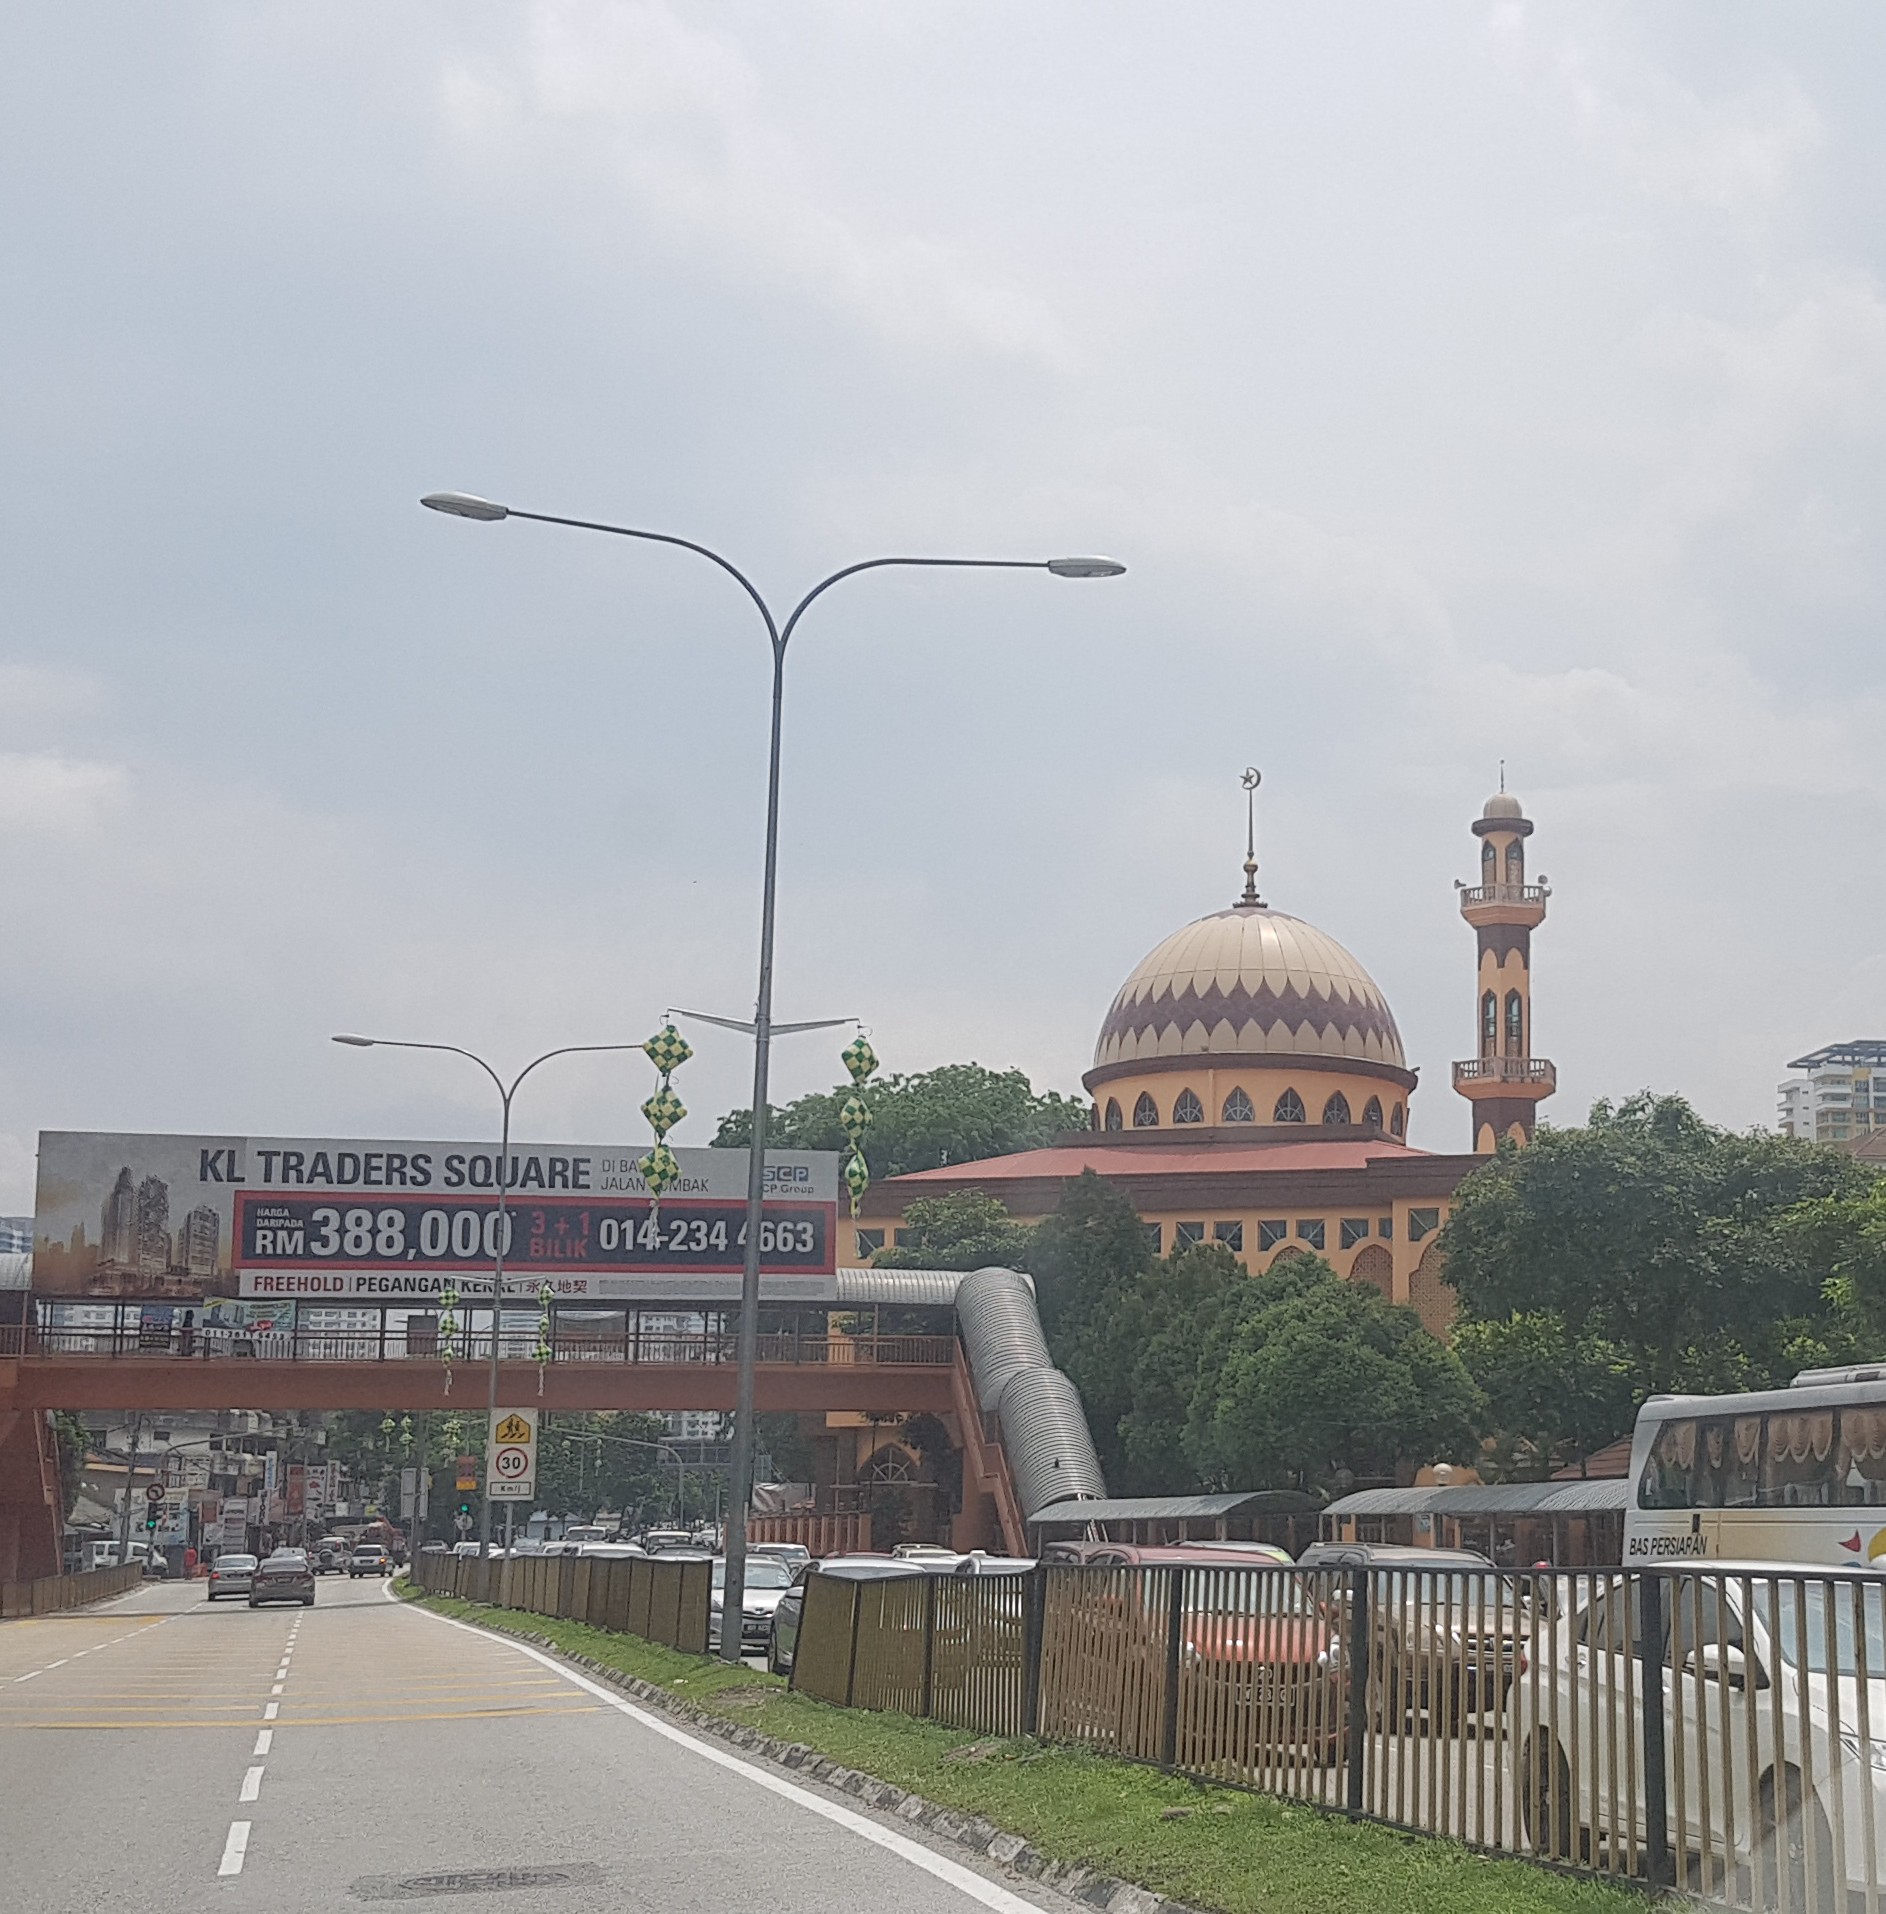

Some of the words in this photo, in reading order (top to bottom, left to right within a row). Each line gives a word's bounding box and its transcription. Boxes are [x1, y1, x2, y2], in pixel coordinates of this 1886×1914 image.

[200, 1149, 245, 1183] KL
[257, 1150, 432, 1187] TRADERS
[443, 1154, 591, 1190] SQUARE
[602, 1160, 615, 1173] DI
[601, 1177, 646, 1192] JALAN
[781, 1184, 814, 1194] Group
[257, 1208, 290, 1217] HARGA
[257, 1219, 304, 1228] DARIPADA
[531, 1211, 546, 1234] 3
[579, 1211, 591, 1235] 1
[255, 1229, 305, 1255] RM
[600, 1218, 728, 1251] 014-234
[529, 1237, 589, 1258] BILIK
[254, 1276, 344, 1292] FREEHOLD
[356, 1277, 456, 1293] PEGANGAN
[501, 1456, 521, 1470] 30
[1629, 1537, 1649, 1556] BAS
[1650, 1535, 1708, 1556] PERSIARAN
